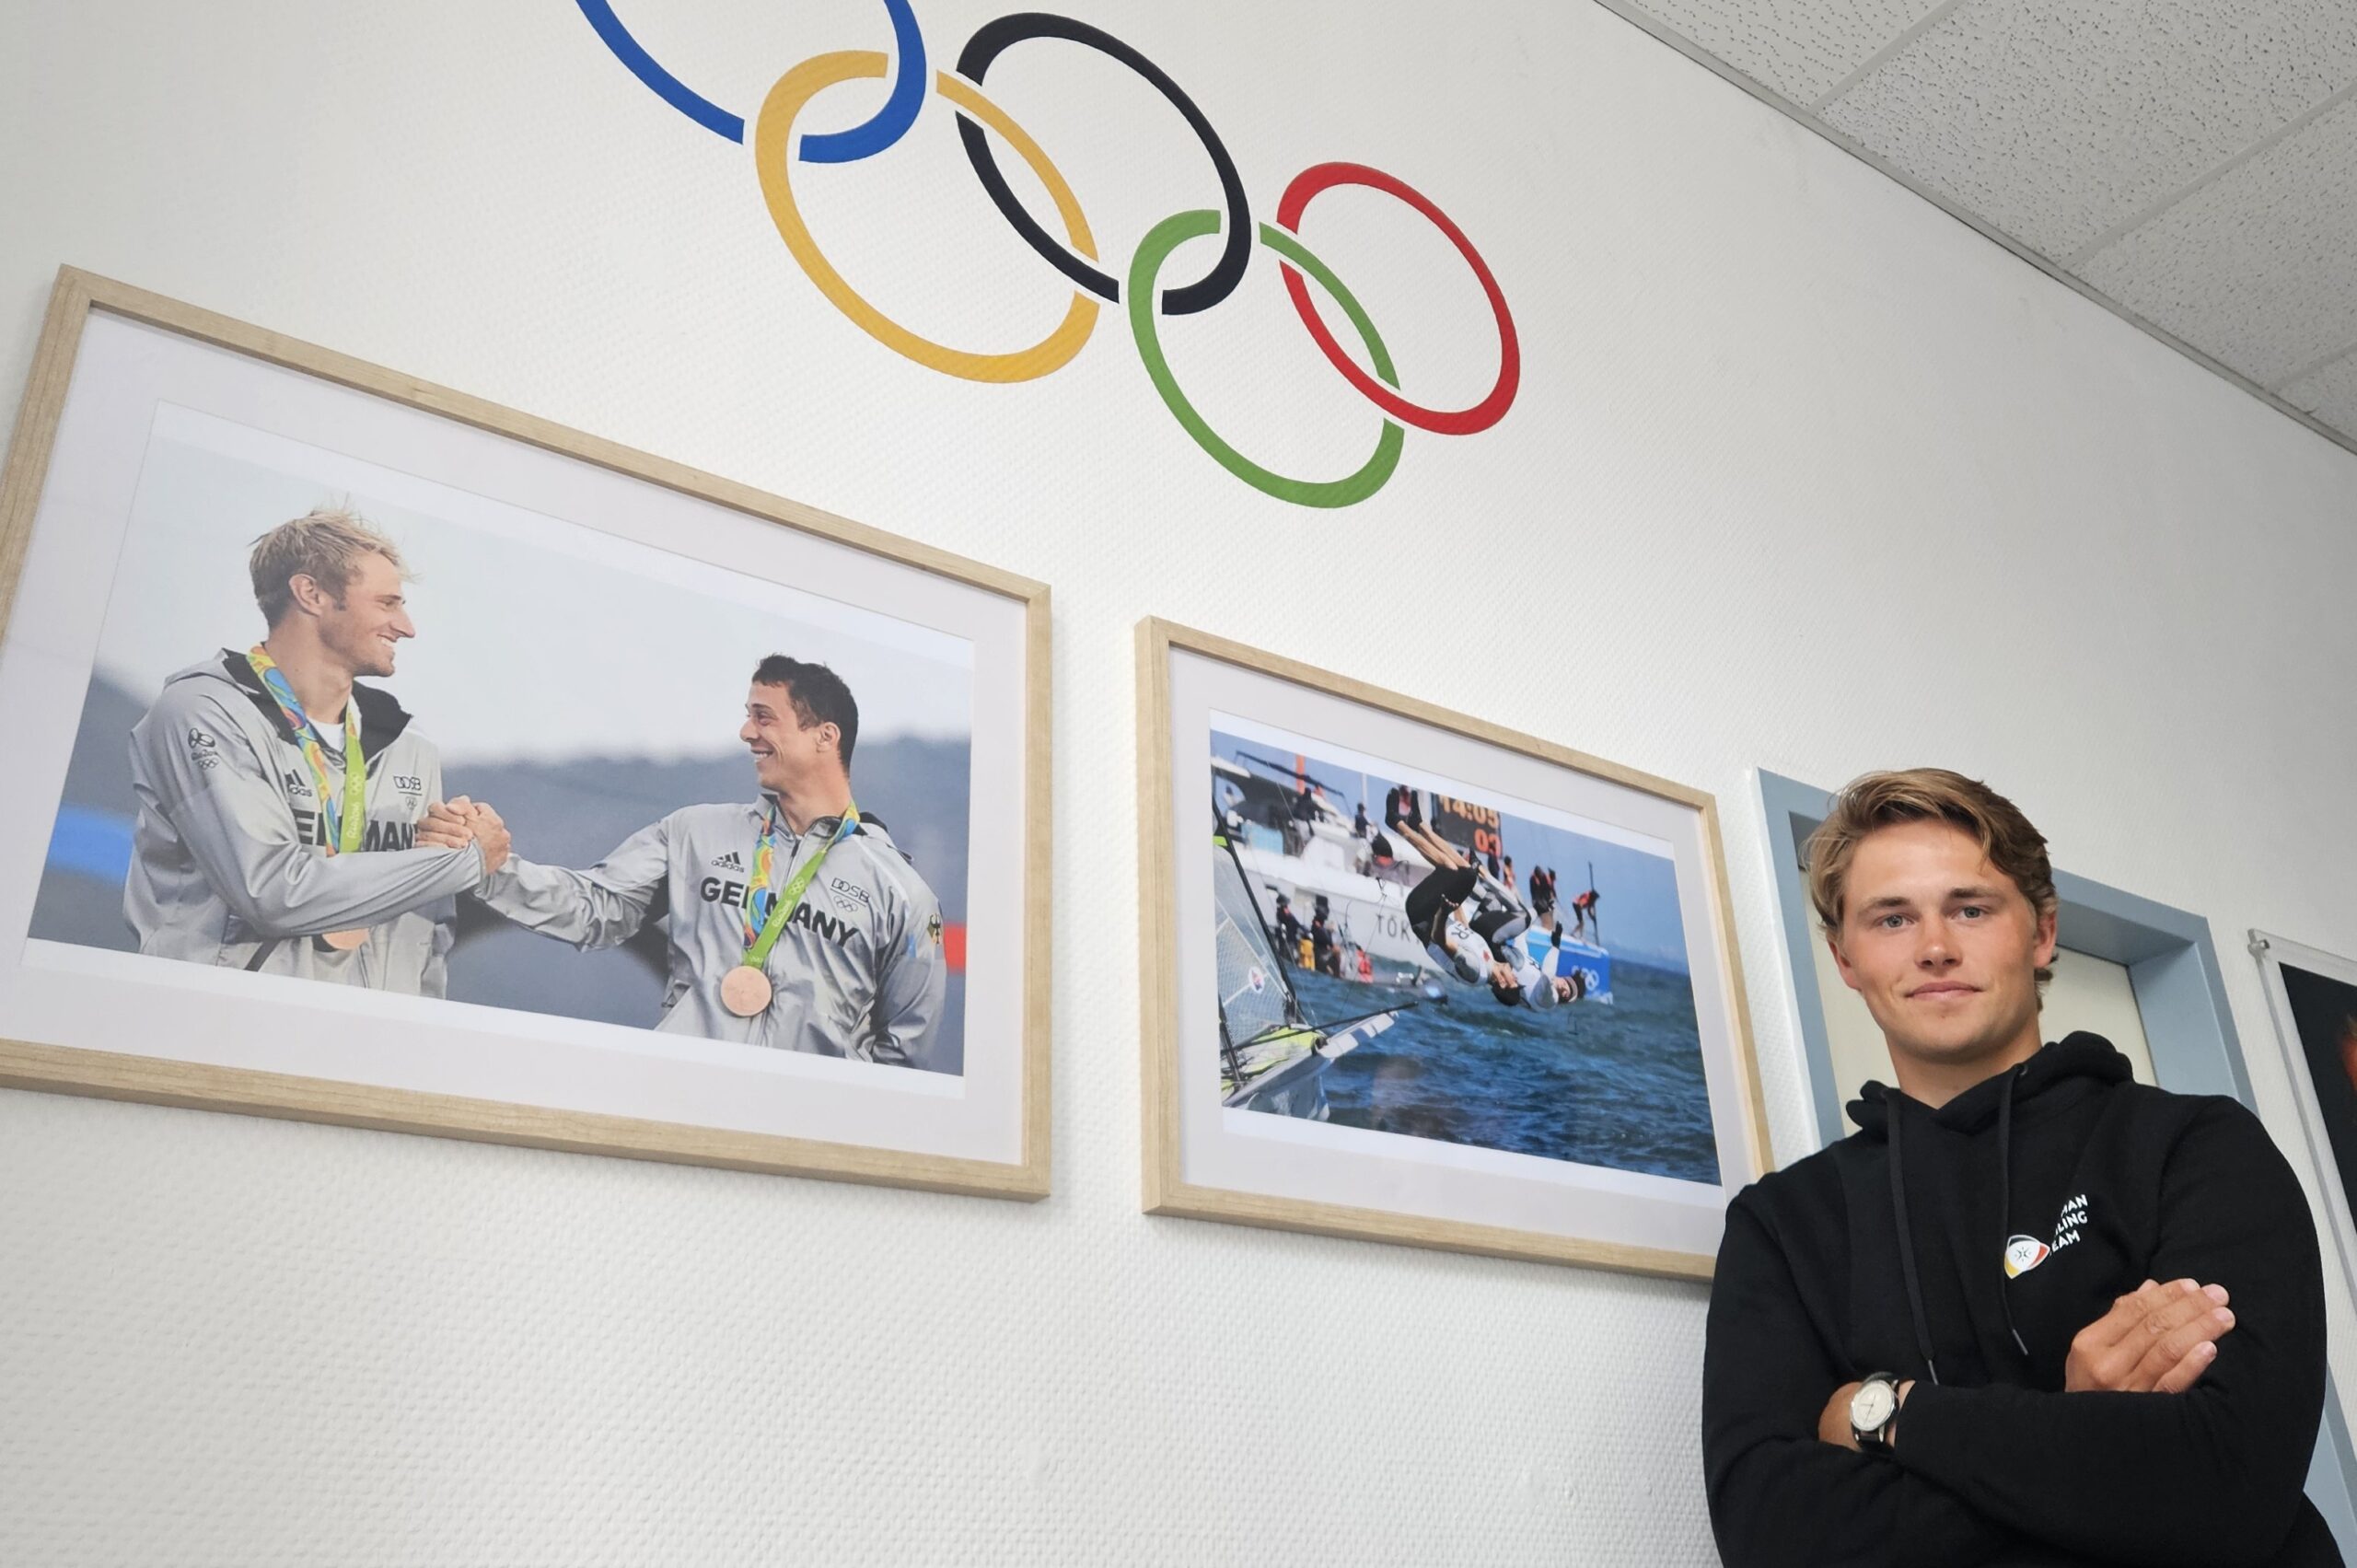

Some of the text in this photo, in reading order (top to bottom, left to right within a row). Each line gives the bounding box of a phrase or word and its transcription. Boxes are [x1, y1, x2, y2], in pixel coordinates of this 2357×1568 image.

[711, 859, 745, 874] adidas
[830, 877, 870, 903] DOSB
[2061, 1193, 2089, 1218] MAN
[2050, 1229, 2081, 1254] EAM
